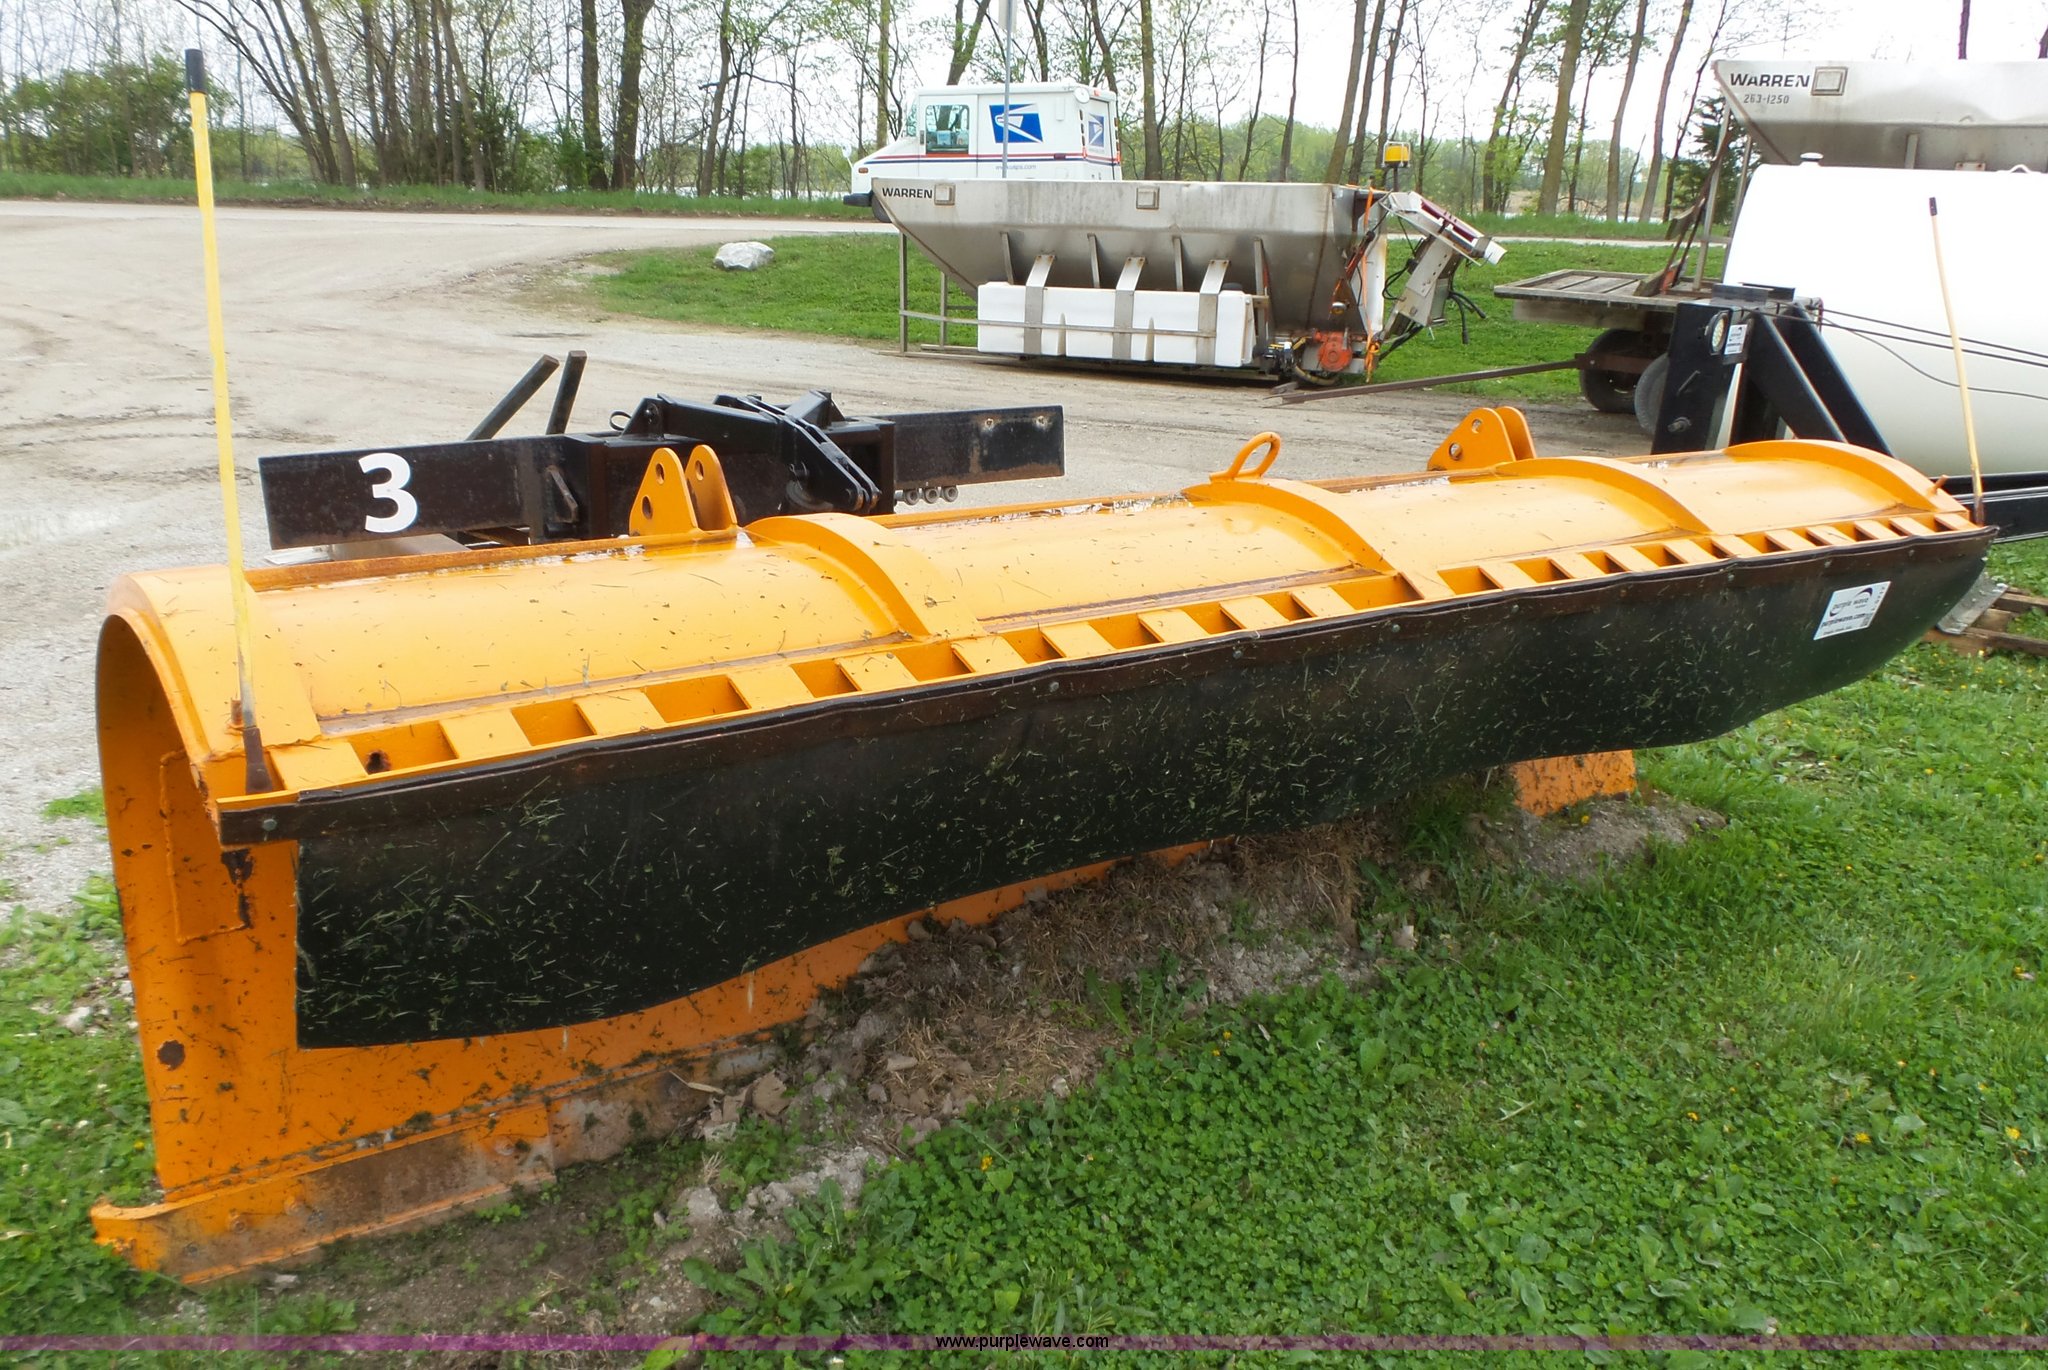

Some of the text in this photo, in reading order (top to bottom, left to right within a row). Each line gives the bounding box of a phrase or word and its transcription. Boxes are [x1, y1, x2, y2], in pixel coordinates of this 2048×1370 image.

[1730, 73, 1811, 88] WARREN
[882, 187, 933, 199] WARREN
[358, 452, 418, 533] 3
